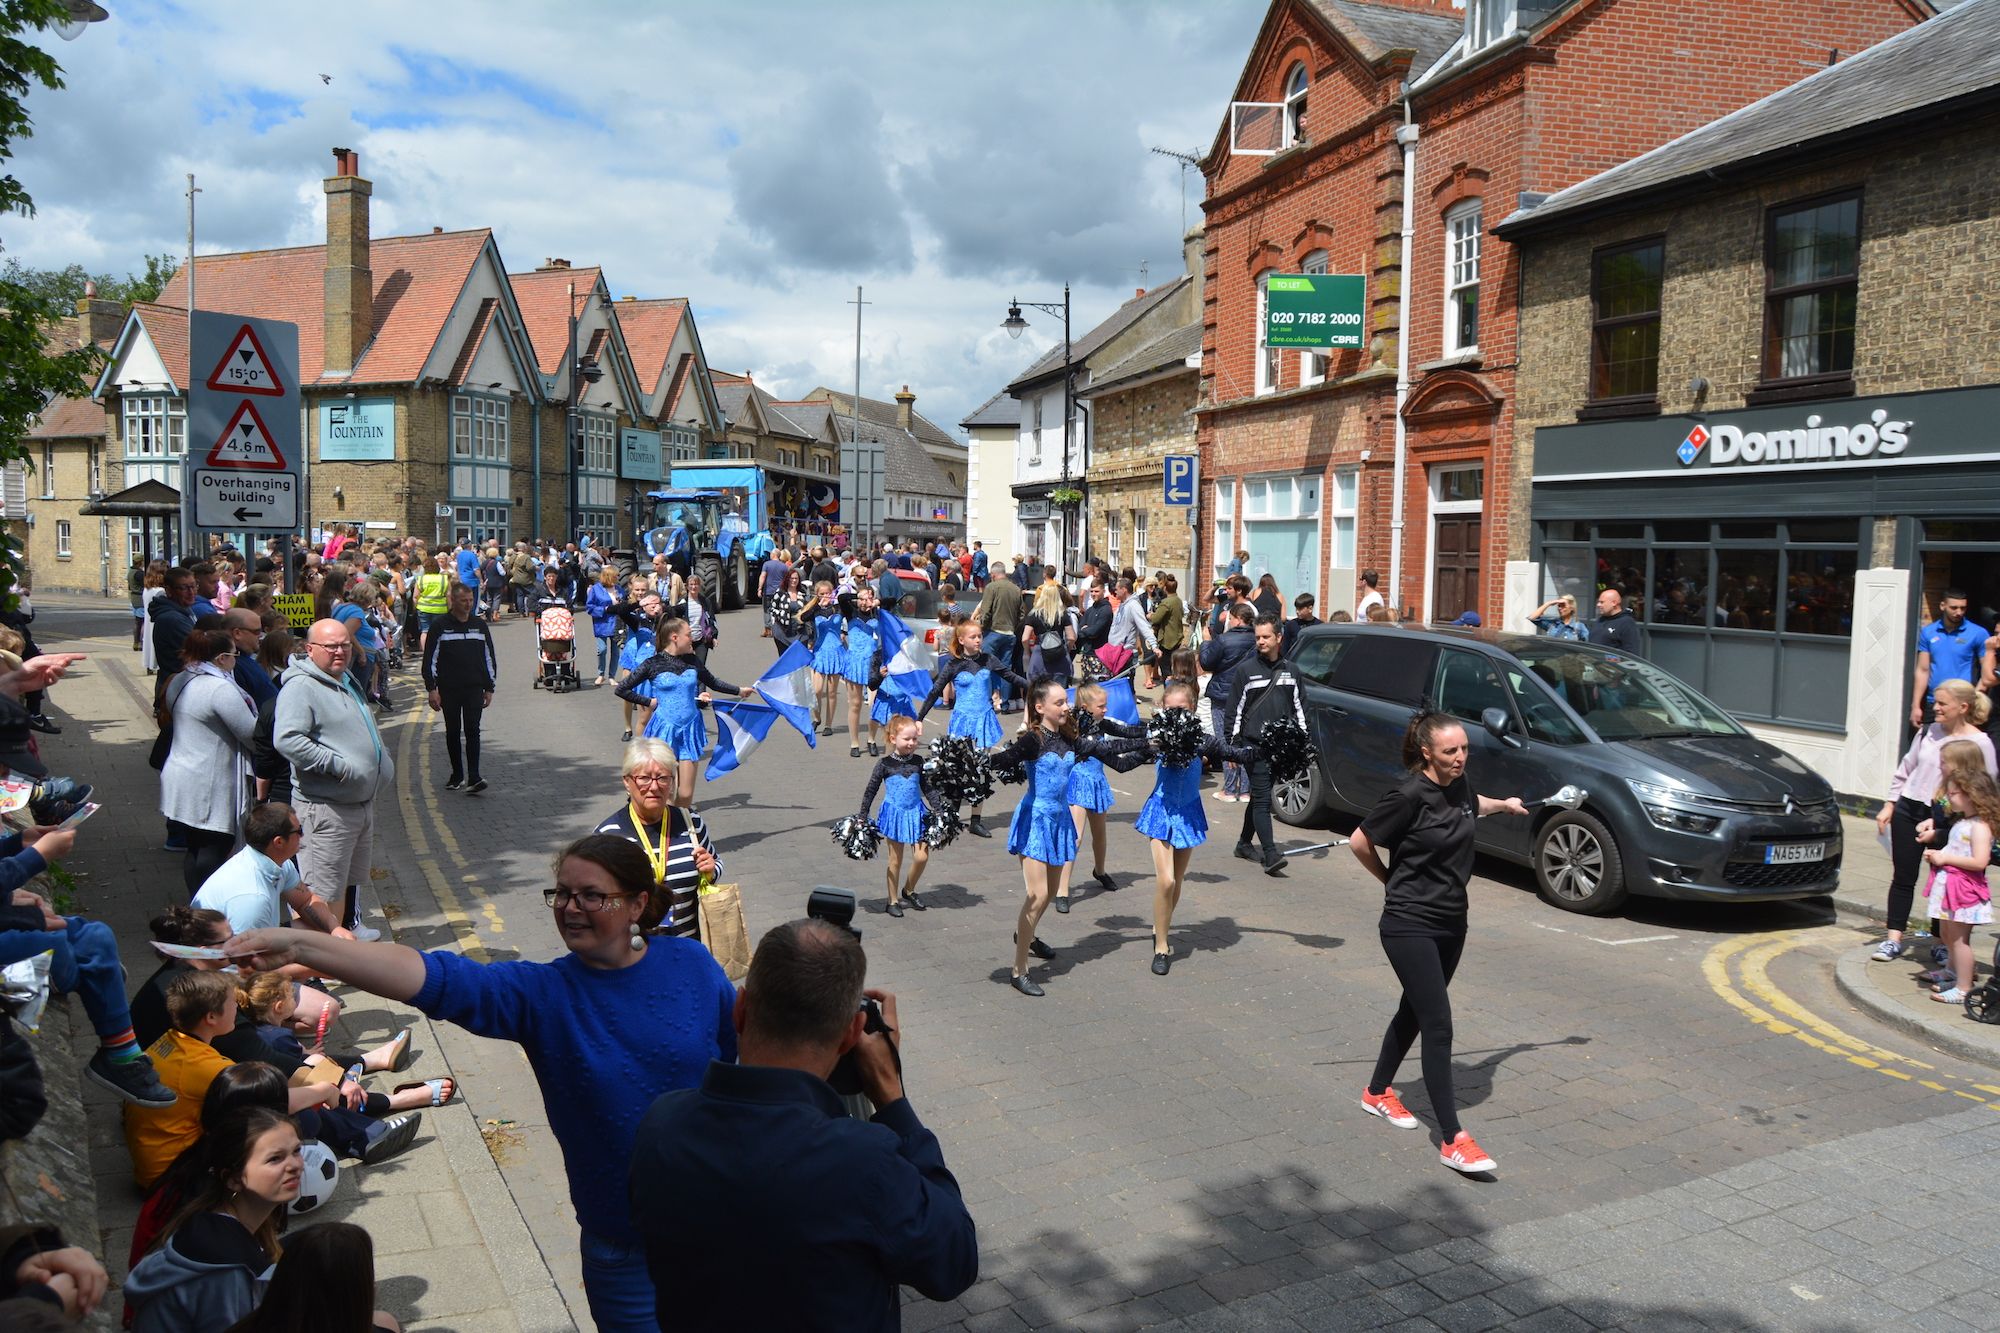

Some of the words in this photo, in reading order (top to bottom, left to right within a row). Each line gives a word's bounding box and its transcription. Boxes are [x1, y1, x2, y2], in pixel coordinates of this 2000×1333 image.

[1276, 281, 1287, 289] TO
[1288, 281, 1301, 289] LET
[1271, 311, 1294, 324] 020
[1298, 312, 1326, 325] 7182
[1329, 313, 1361, 325] 2000
[1271, 336, 1322, 344] cbre.co.uk/shops
[1330, 335, 1359, 344] CBRE
[352, 415, 368, 424] THE
[1709, 408, 1909, 464] Domino's
[1170, 459, 1189, 486] P
[202, 475, 290, 491] Overhanging
[219, 490, 275, 505] building
[1773, 846, 1801, 860] NA65
